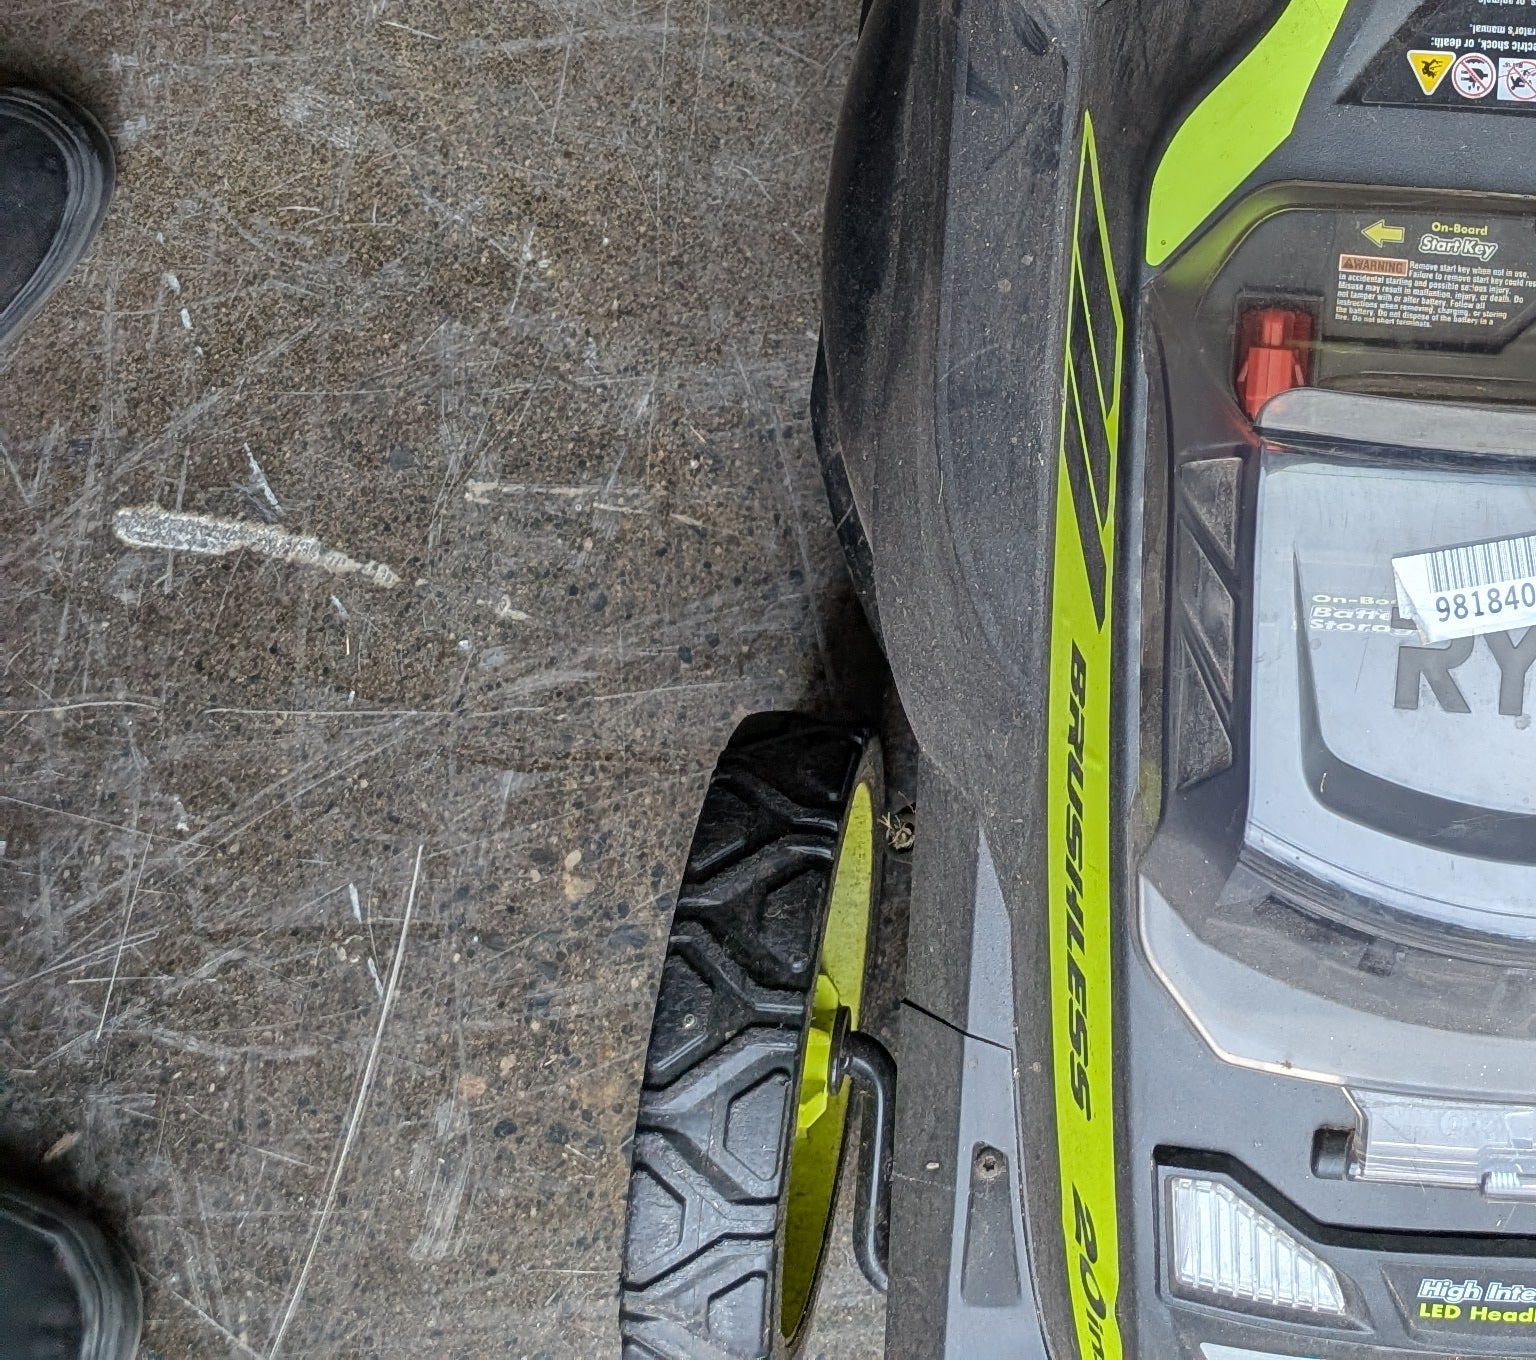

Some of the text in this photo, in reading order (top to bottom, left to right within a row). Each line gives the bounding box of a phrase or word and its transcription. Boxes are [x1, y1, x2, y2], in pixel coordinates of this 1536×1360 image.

[1469, 24, 1505, 34] manual.
[1430, 36, 1461, 48] death:
[1463, 38, 1474, 46] or
[1477, 38, 1509, 51] shock,
[1431, 221, 1488, 236] On-Board
[1418, 233, 1499, 262] Start Key
[1353, 259, 1402, 272] WARNING
[1408, 270, 1433, 278] Failure
[1472, 275, 1489, 283] start
[1490, 276, 1503, 285] key
[1504, 277, 1523, 285] could
[1064, 638, 1091, 1122] BRUSHLESS
[1417, 1278, 1483, 1304] High
[1419, 1303, 1462, 1320] LED
